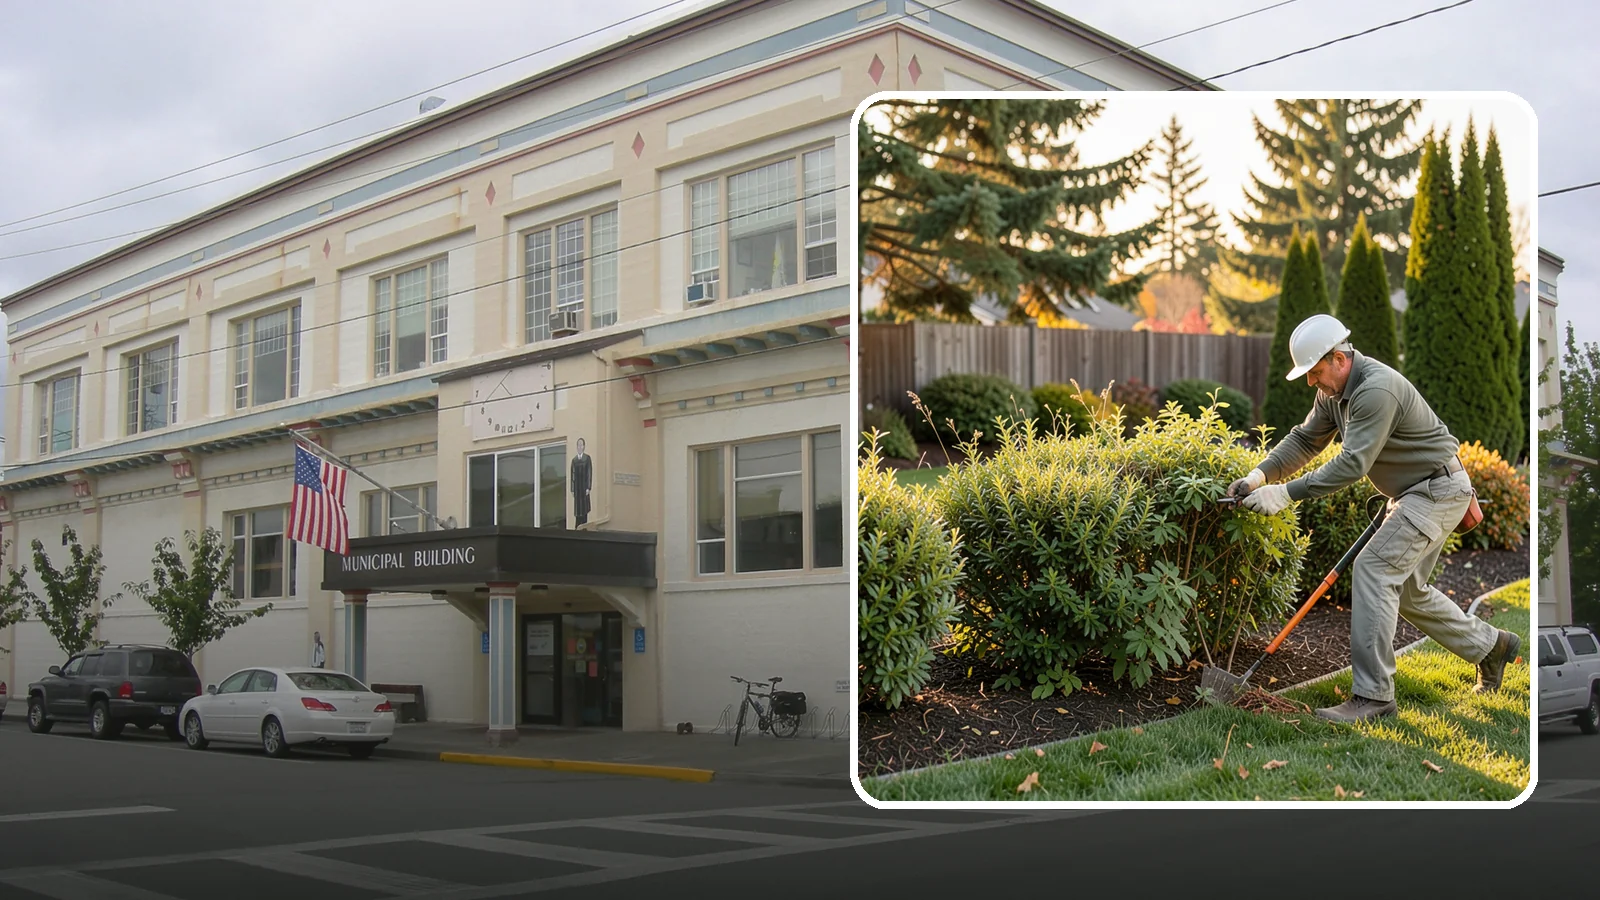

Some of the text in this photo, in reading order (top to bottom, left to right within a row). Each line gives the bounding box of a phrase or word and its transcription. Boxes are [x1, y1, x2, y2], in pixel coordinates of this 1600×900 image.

[521, 420, 525, 428] 2
[342, 547, 475, 571] MUNICIPAL BUILDING
